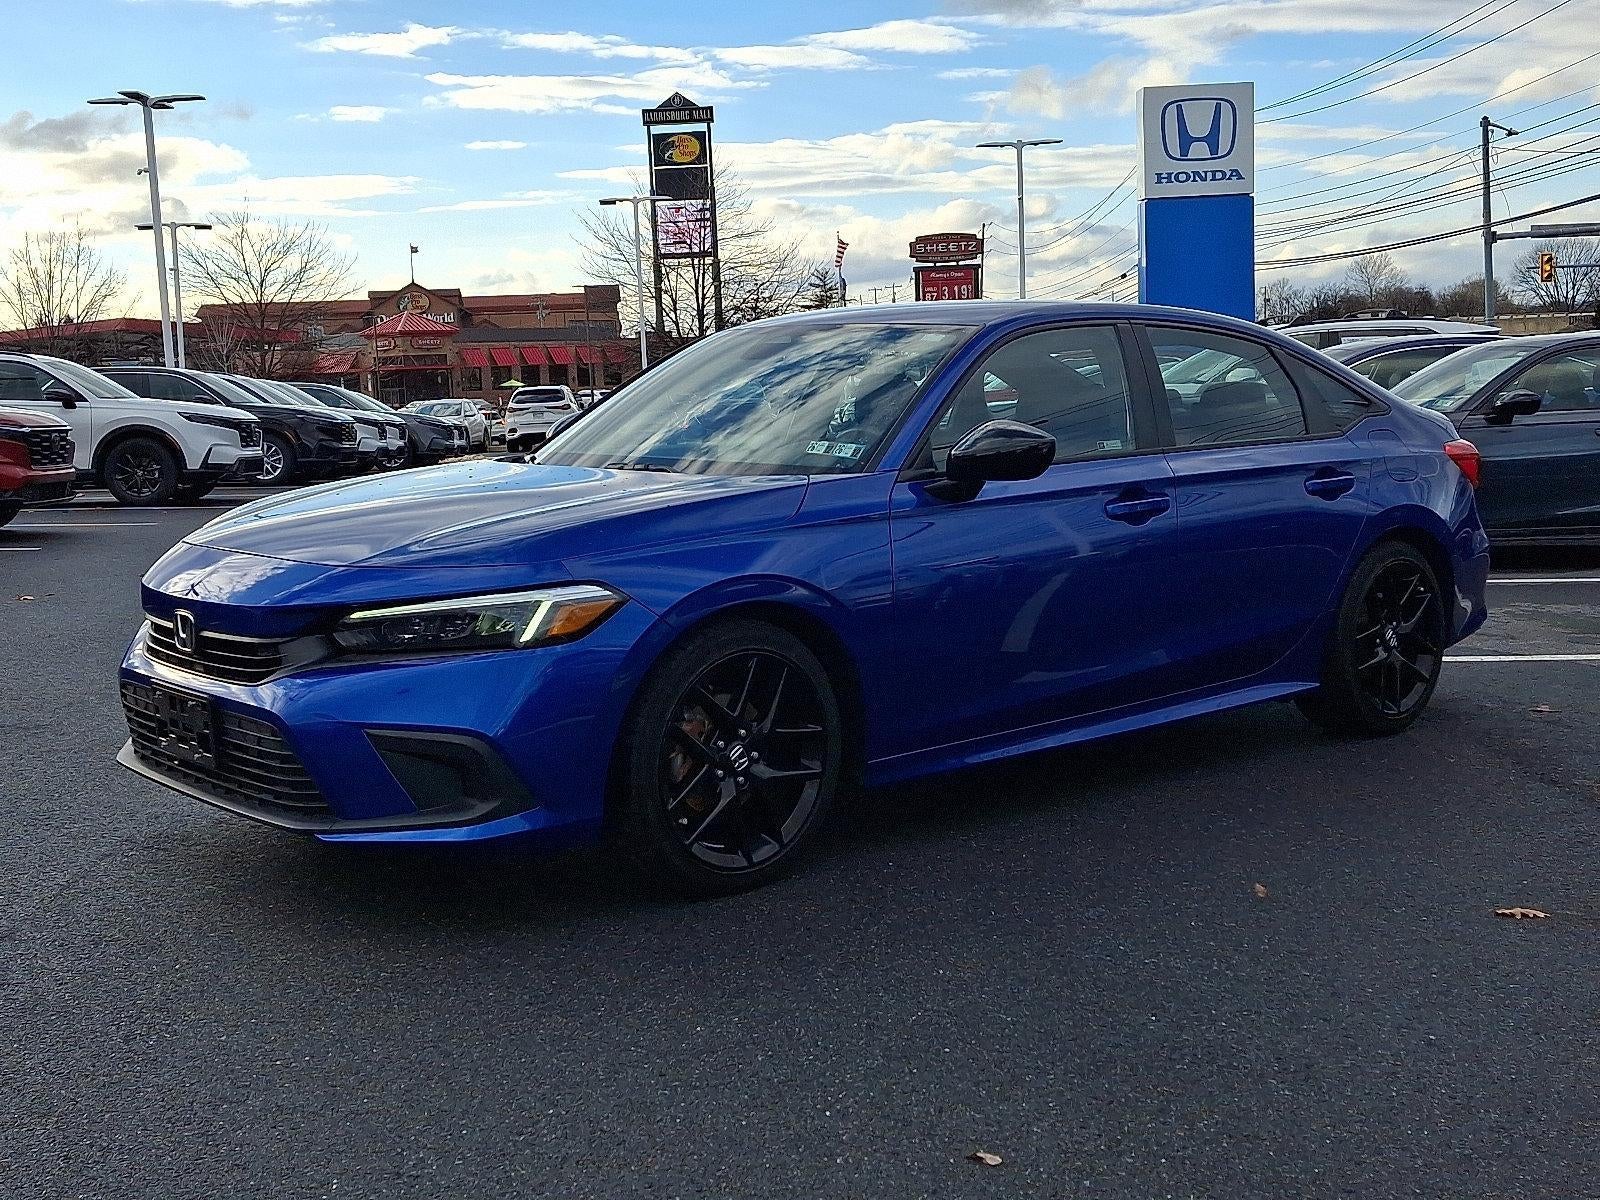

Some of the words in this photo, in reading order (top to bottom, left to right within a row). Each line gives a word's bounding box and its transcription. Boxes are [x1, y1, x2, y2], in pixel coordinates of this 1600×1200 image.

[644, 110, 690, 122] HARRISBURG
[692, 109, 712, 120] MALL
[679, 149, 697, 158] Shops
[1154, 168, 1245, 185] HONDA
[916, 241, 977, 253] SHEETZ
[925, 292, 938, 300] 87
[422, 312, 455, 322] World
